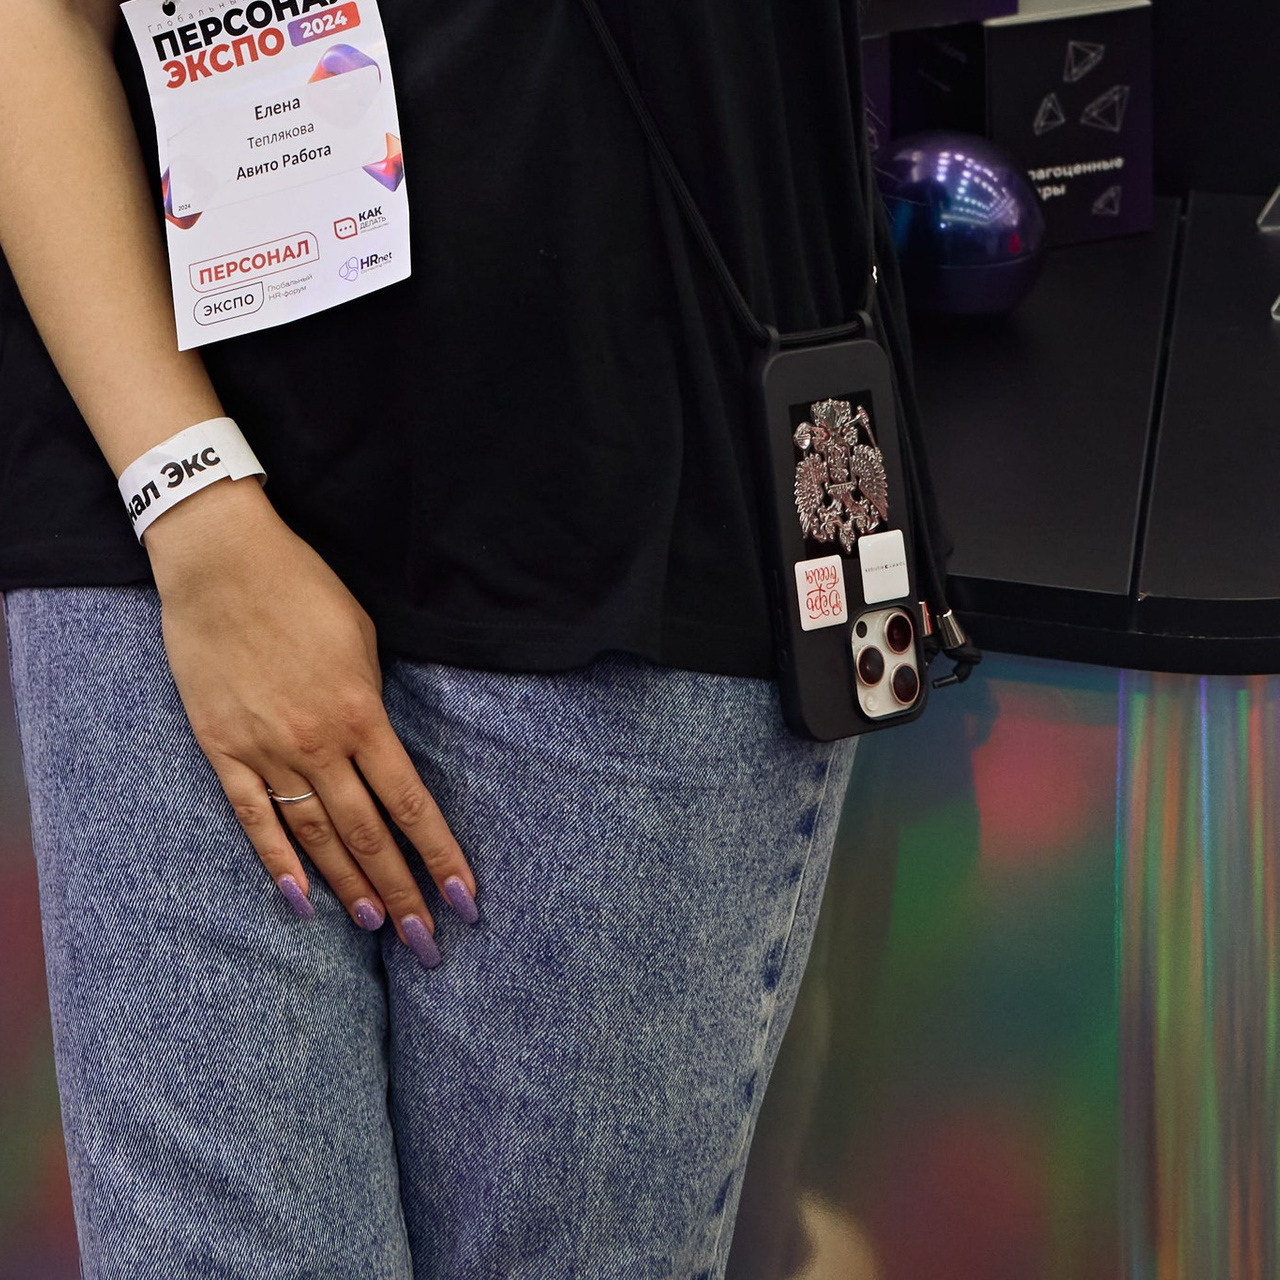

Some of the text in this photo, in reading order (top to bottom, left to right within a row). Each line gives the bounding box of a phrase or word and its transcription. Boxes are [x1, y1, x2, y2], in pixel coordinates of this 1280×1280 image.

[163, 10, 348, 89] ЭКСПО 2024
[254, 96, 301, 121] Елена
[247, 121, 315, 150] Теплякова
[235, 143, 332, 181] Авито Работа
[358, 205, 383, 223] КАК
[359, 216, 387, 230] ДЕЛАТЬ
[198, 239, 311, 285] ПЕРСОНАЛ
[360, 251, 393, 270] HRnet
[203, 293, 255, 317] ЭКСПО
[160, 447, 221, 488] Экс
